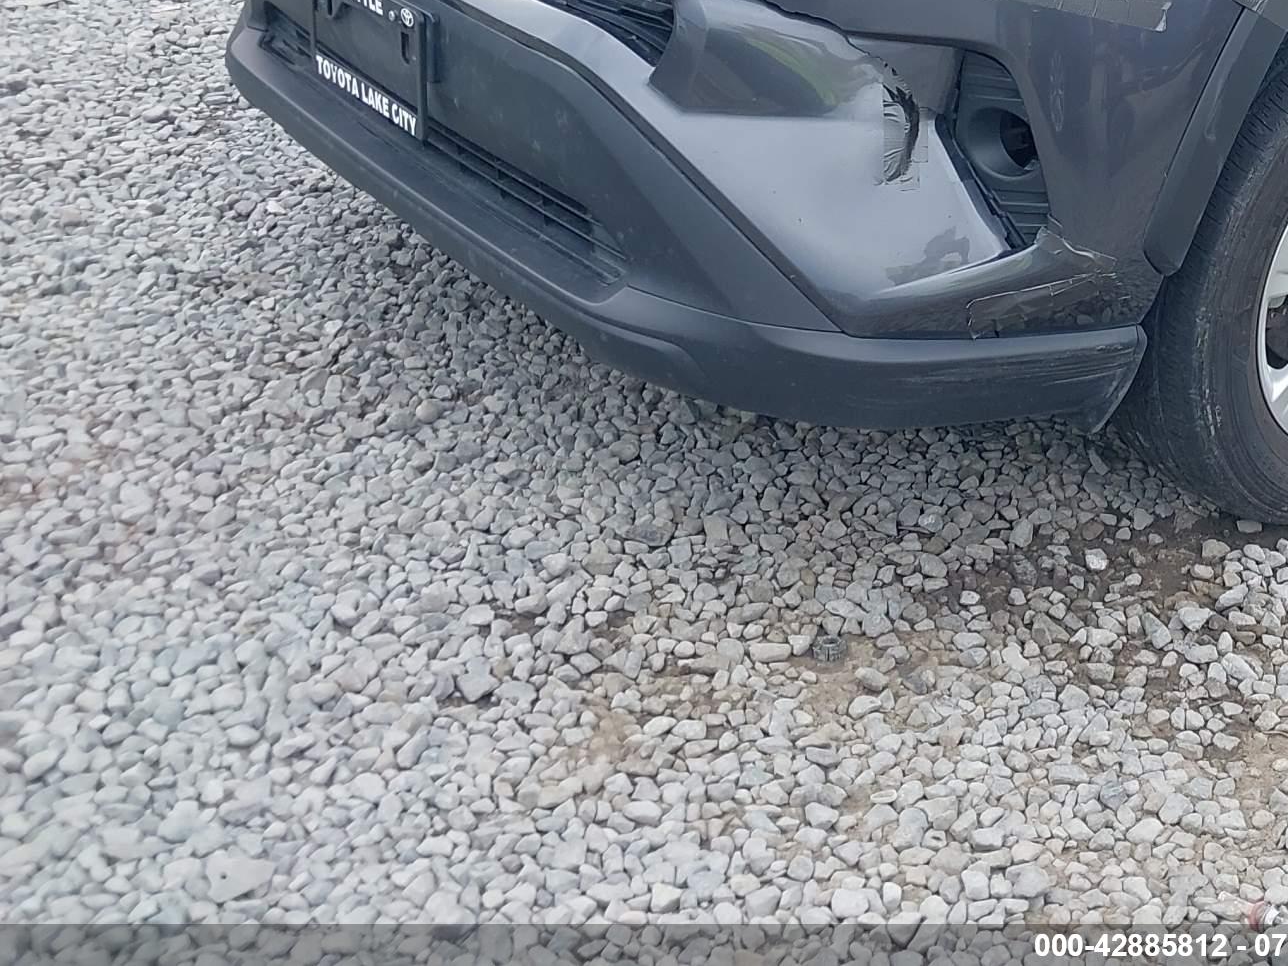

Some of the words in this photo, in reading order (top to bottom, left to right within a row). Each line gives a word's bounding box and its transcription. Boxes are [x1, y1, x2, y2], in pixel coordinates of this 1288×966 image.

[316, 55, 360, 99] TOYOTA
[361, 82, 390, 118] LAKE
[391, 102, 417, 136] CITY
